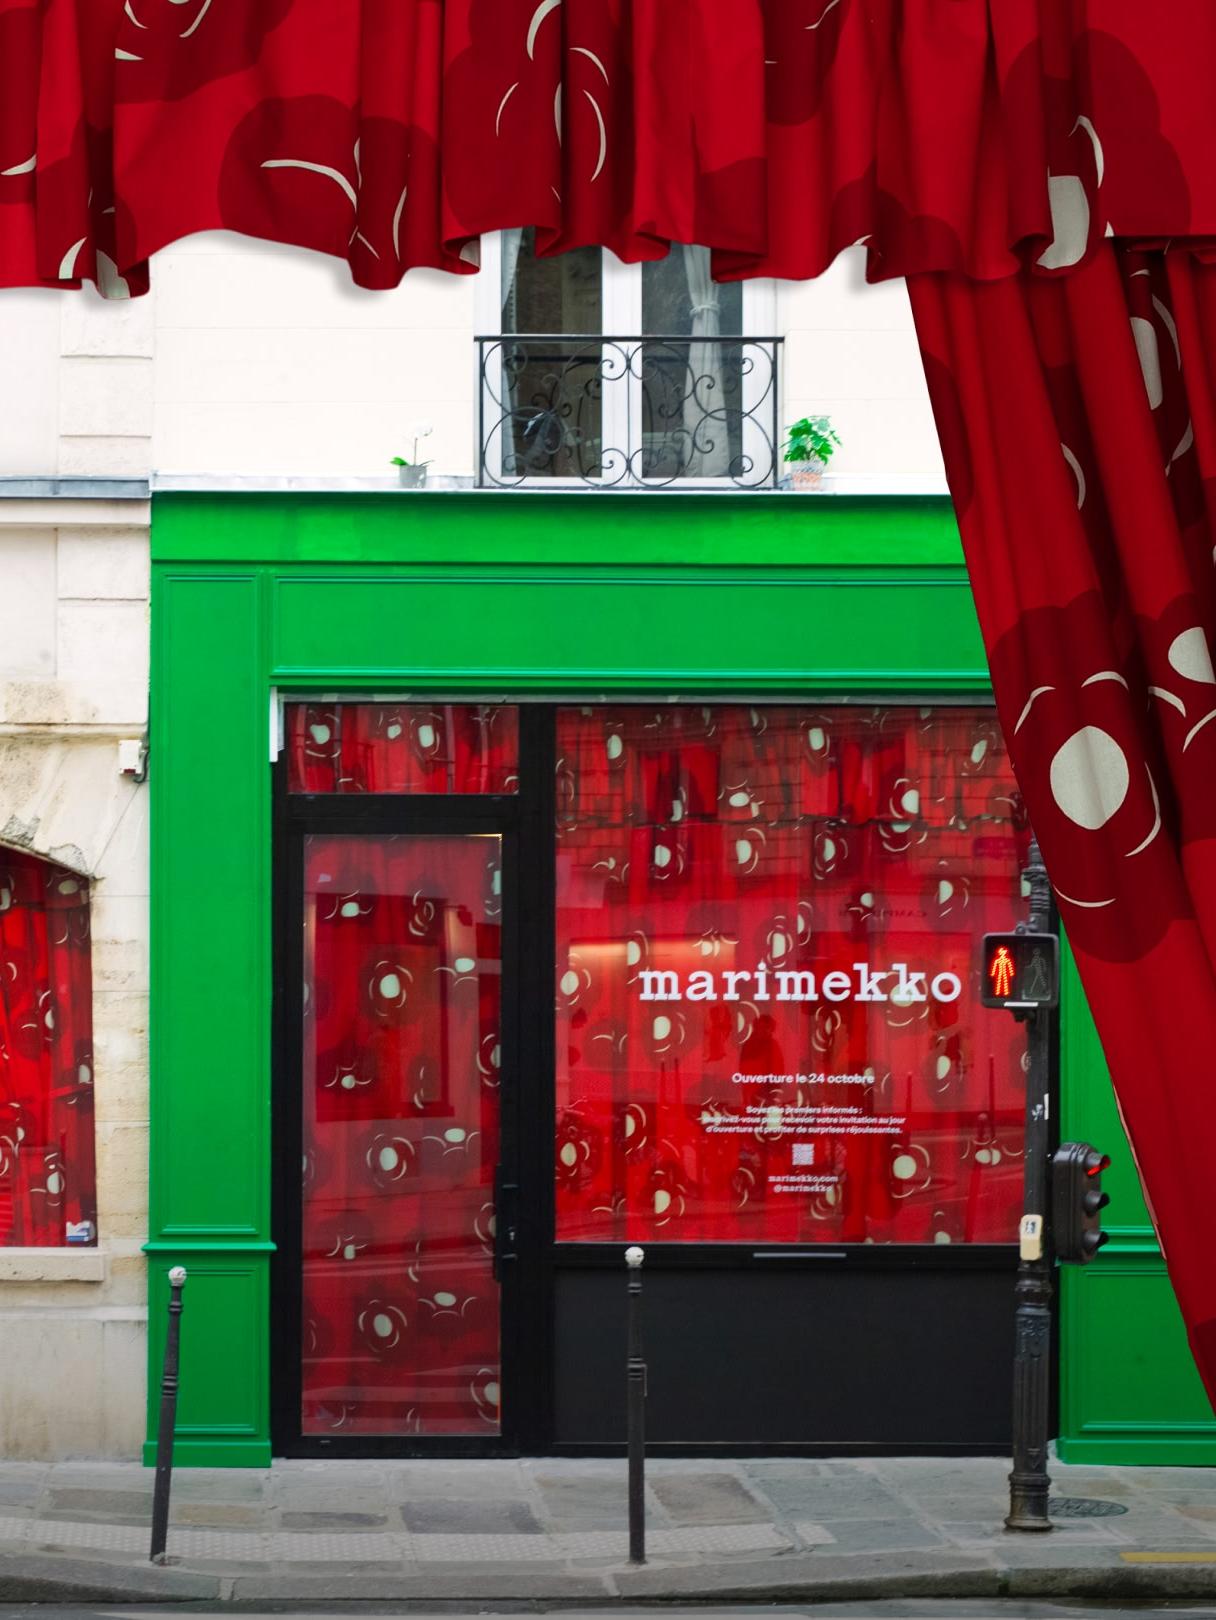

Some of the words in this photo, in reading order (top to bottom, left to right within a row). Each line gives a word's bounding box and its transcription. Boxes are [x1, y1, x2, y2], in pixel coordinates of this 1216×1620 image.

[638, 962, 962, 1003] marimekko
[731, 1072, 794, 1084] Ouverture
[795, 1072, 808, 1084] le
[808, 1072, 826, 1084] 24
[827, 1072, 875, 1084] octobre
[746, 1105, 769, 1114] Soye
